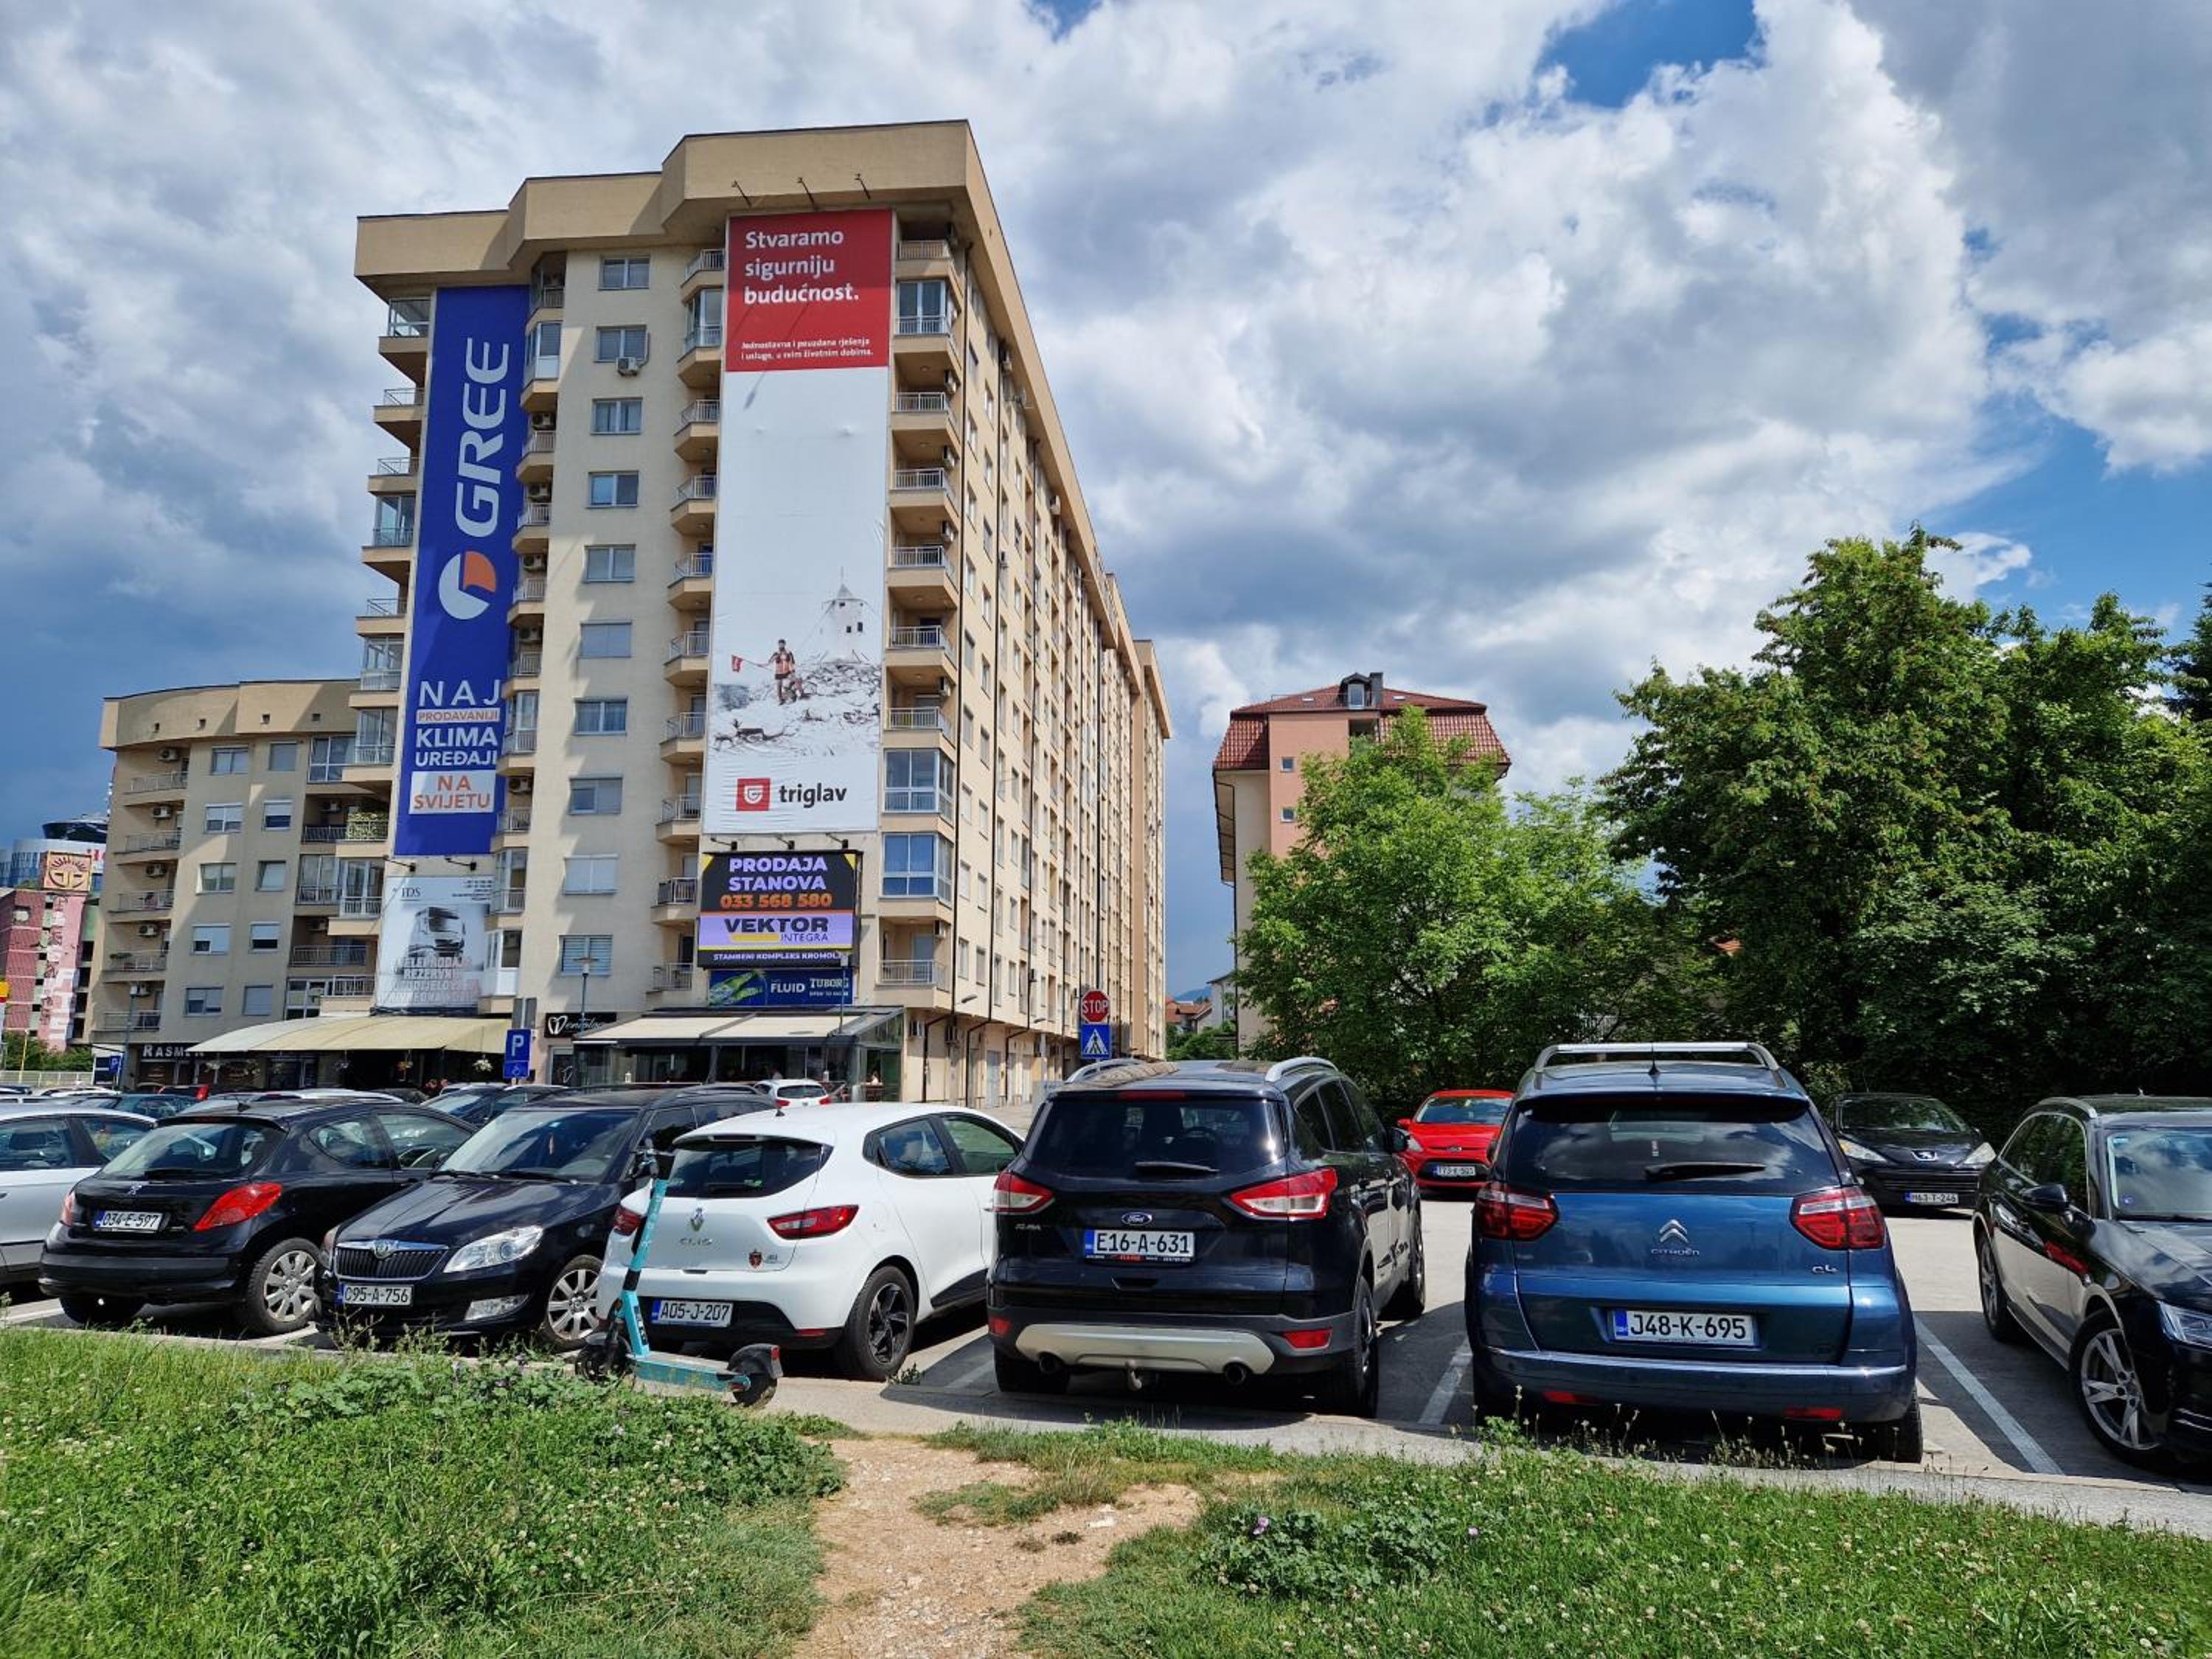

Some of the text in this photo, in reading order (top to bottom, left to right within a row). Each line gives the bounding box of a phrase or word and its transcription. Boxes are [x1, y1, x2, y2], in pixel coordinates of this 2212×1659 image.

[745, 230, 844, 249] Stvaramo
[745, 255, 835, 281] sigurniju
[744, 283, 859, 305] budućnost.
[455, 337, 509, 538] GREE
[419, 679, 501, 707] NAJ
[418, 711, 497, 722] PRODAVANIJI
[416, 726, 498, 748] KLIMA
[415, 750, 496, 767] UREĐAJI
[437, 776, 472, 791] NA
[414, 793, 490, 810] SVIJETU
[779, 782, 847, 808] triglav
[729, 857, 827, 873] PRODAJA
[728, 875, 827, 891] STANOVA
[720, 894, 754, 908] 033
[797, 893, 832, 908] 580
[724, 917, 829, 933] VEKTOR
[779, 933, 829, 942] INTEGRA
[802, 952, 842, 960] KROMOL
[771, 983, 805, 993] FLUID
[810, 978, 849, 990] TUBORG
[1083, 1000, 1108, 1014] STOP
[512, 1035, 524, 1056] P
[1096, 1232, 1190, 1253] E16-A-631
[660, 1301, 730, 1321] A05-J-207
[1630, 1314, 1746, 1340] J48-K-695
